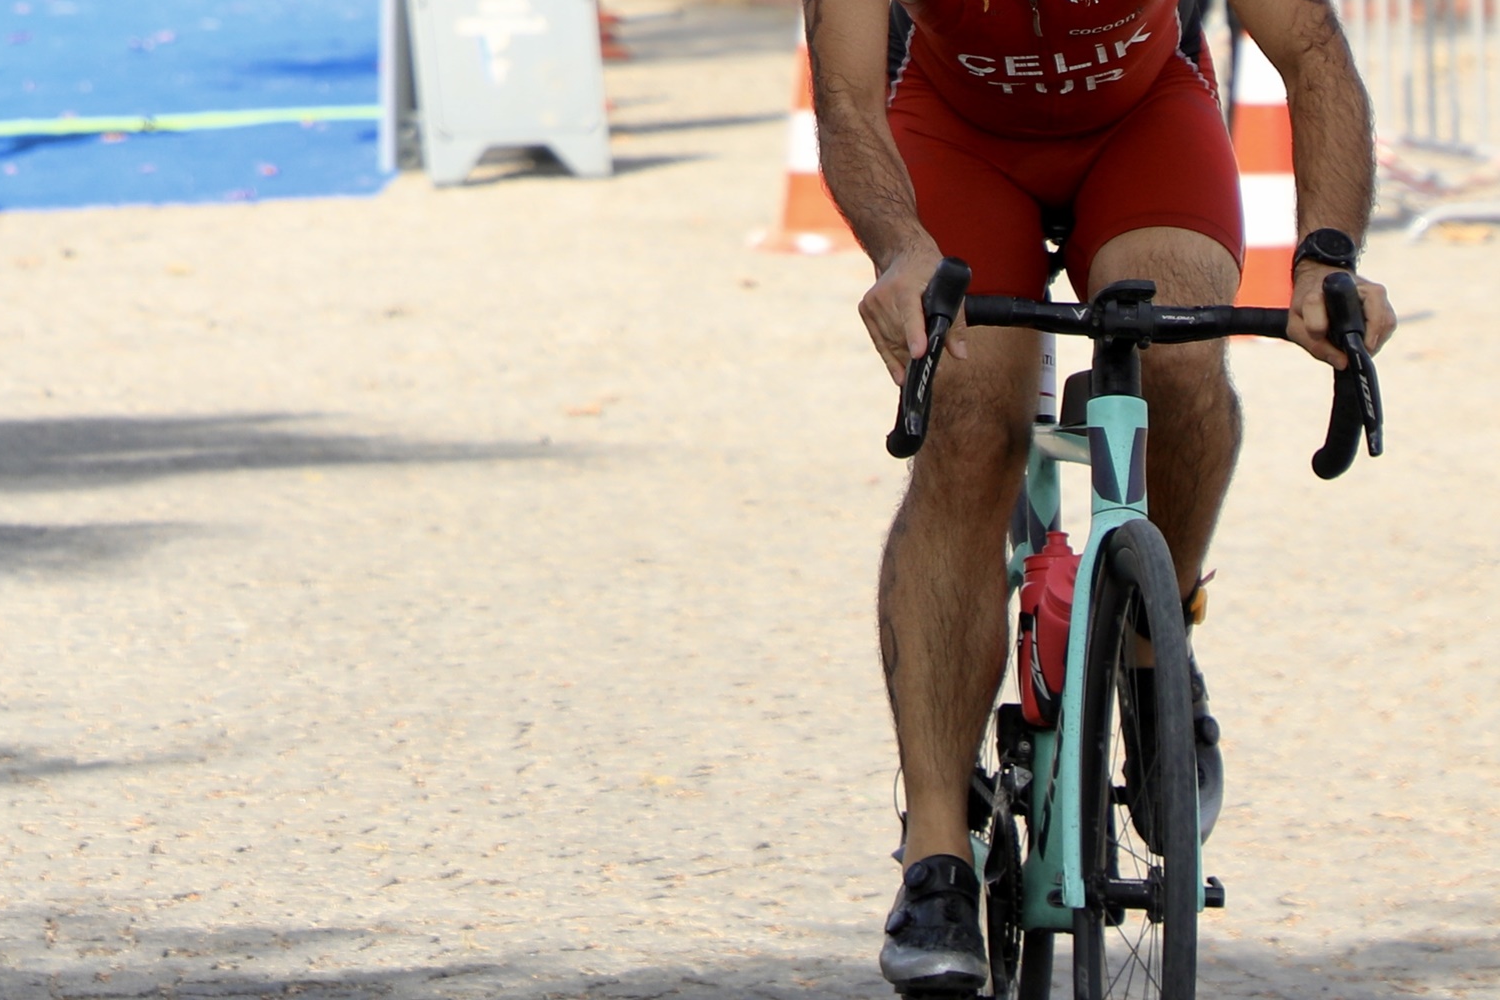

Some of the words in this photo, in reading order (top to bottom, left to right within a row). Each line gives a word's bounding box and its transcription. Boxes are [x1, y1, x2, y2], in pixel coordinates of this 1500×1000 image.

[1068, 12, 1135, 37] cocoon
[957, 22, 1152, 77] ÇELİK
[987, 68, 1126, 95] TUR
